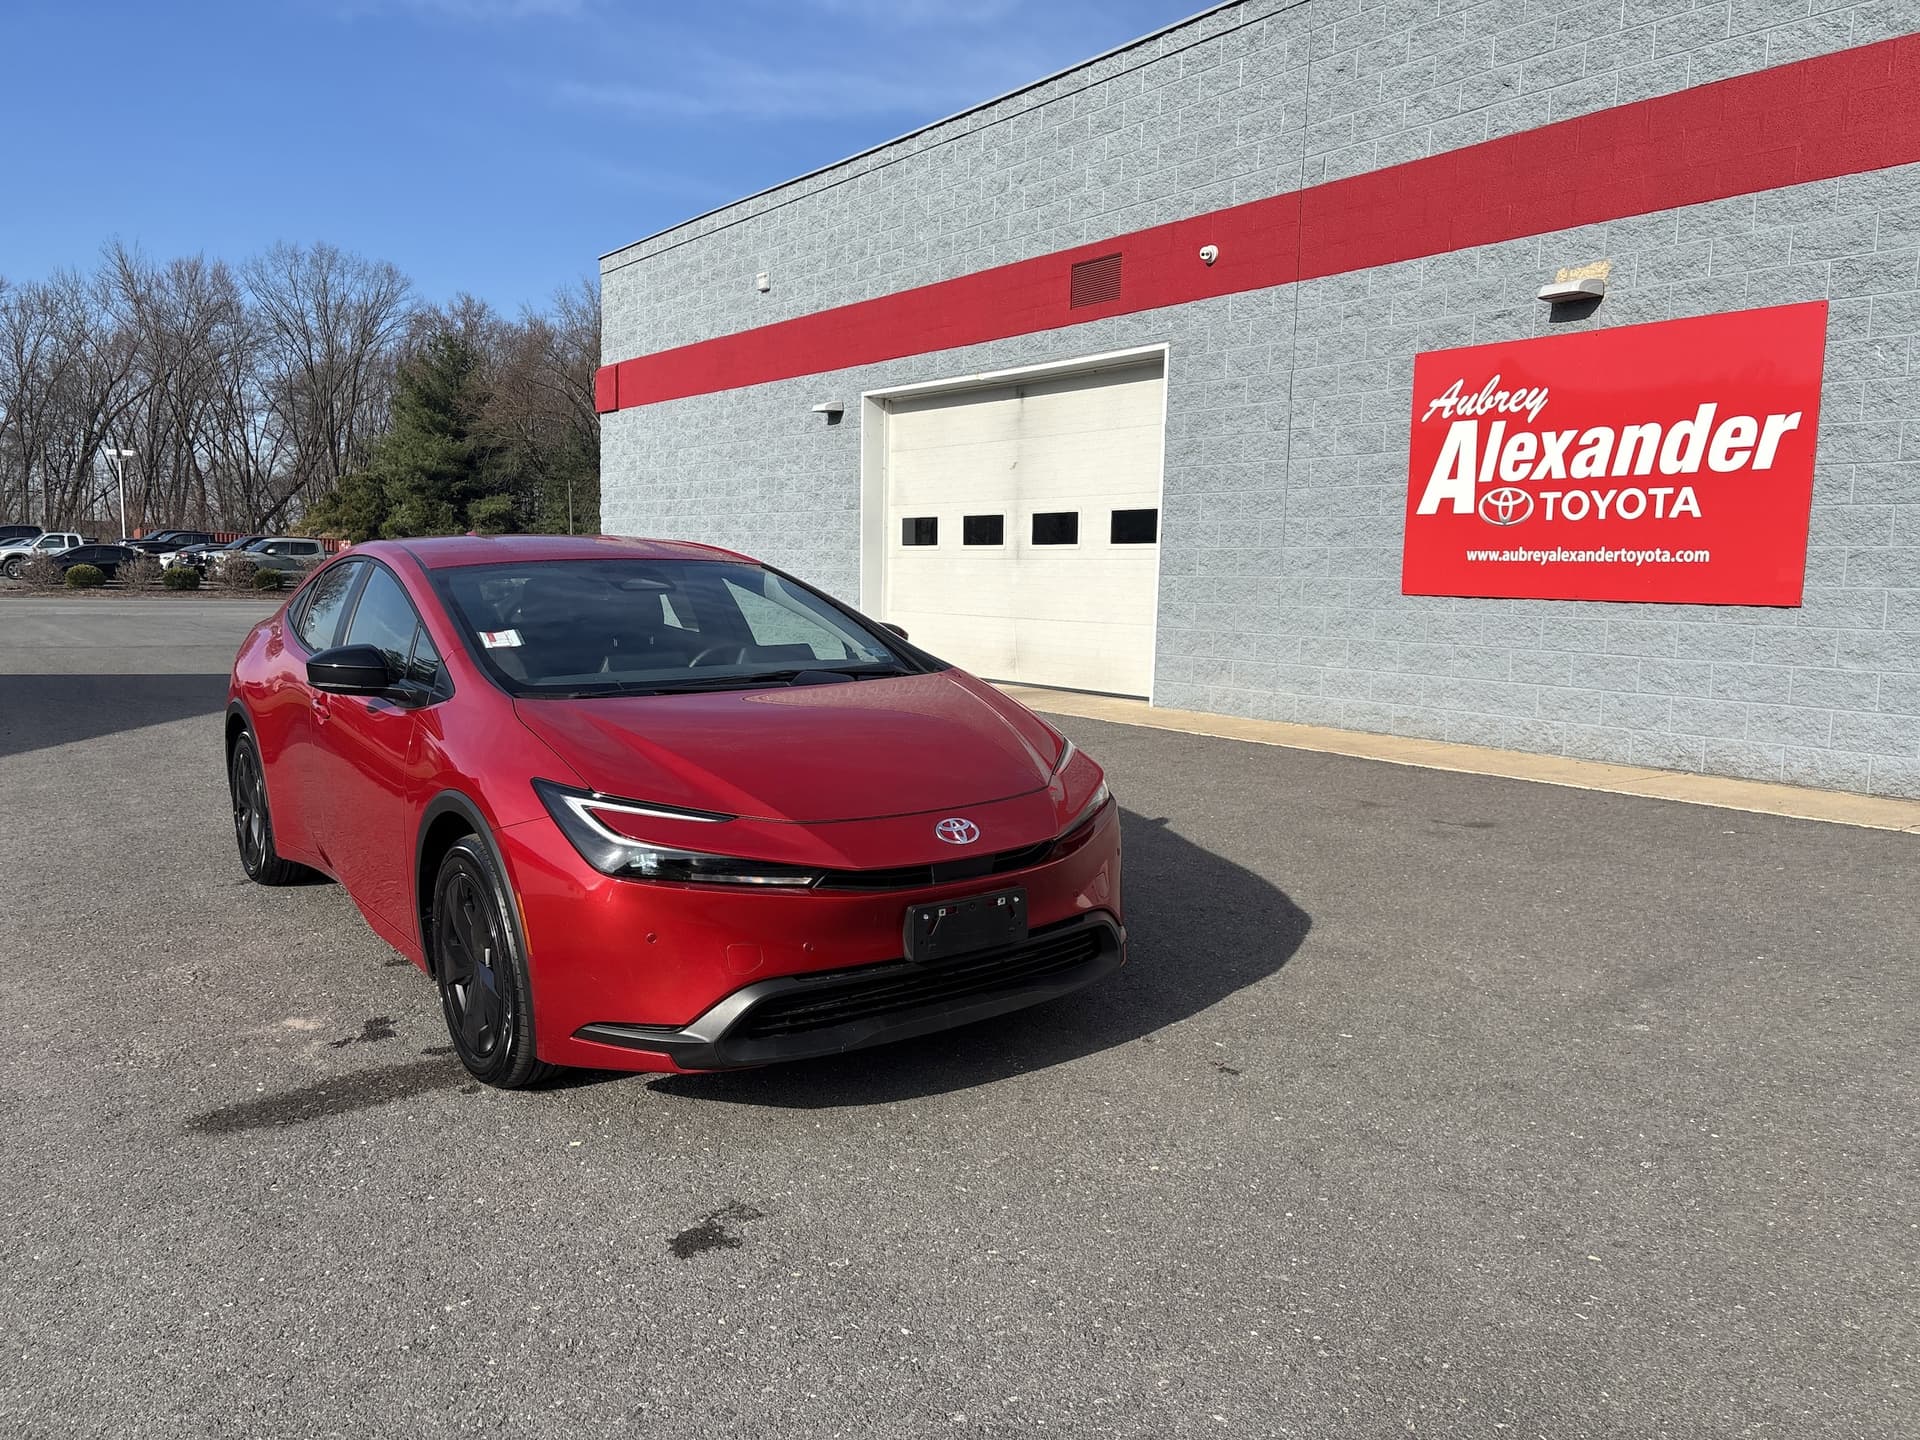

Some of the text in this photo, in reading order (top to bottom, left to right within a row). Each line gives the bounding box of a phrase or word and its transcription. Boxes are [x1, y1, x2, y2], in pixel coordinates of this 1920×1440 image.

[1421, 374, 1549, 423] Aubrey
[1416, 403, 1802, 515] Alexander
[1540, 486, 1702, 521] TOYOTA
[1466, 546, 1710, 567] www.aubreyalexandertoyota.com
